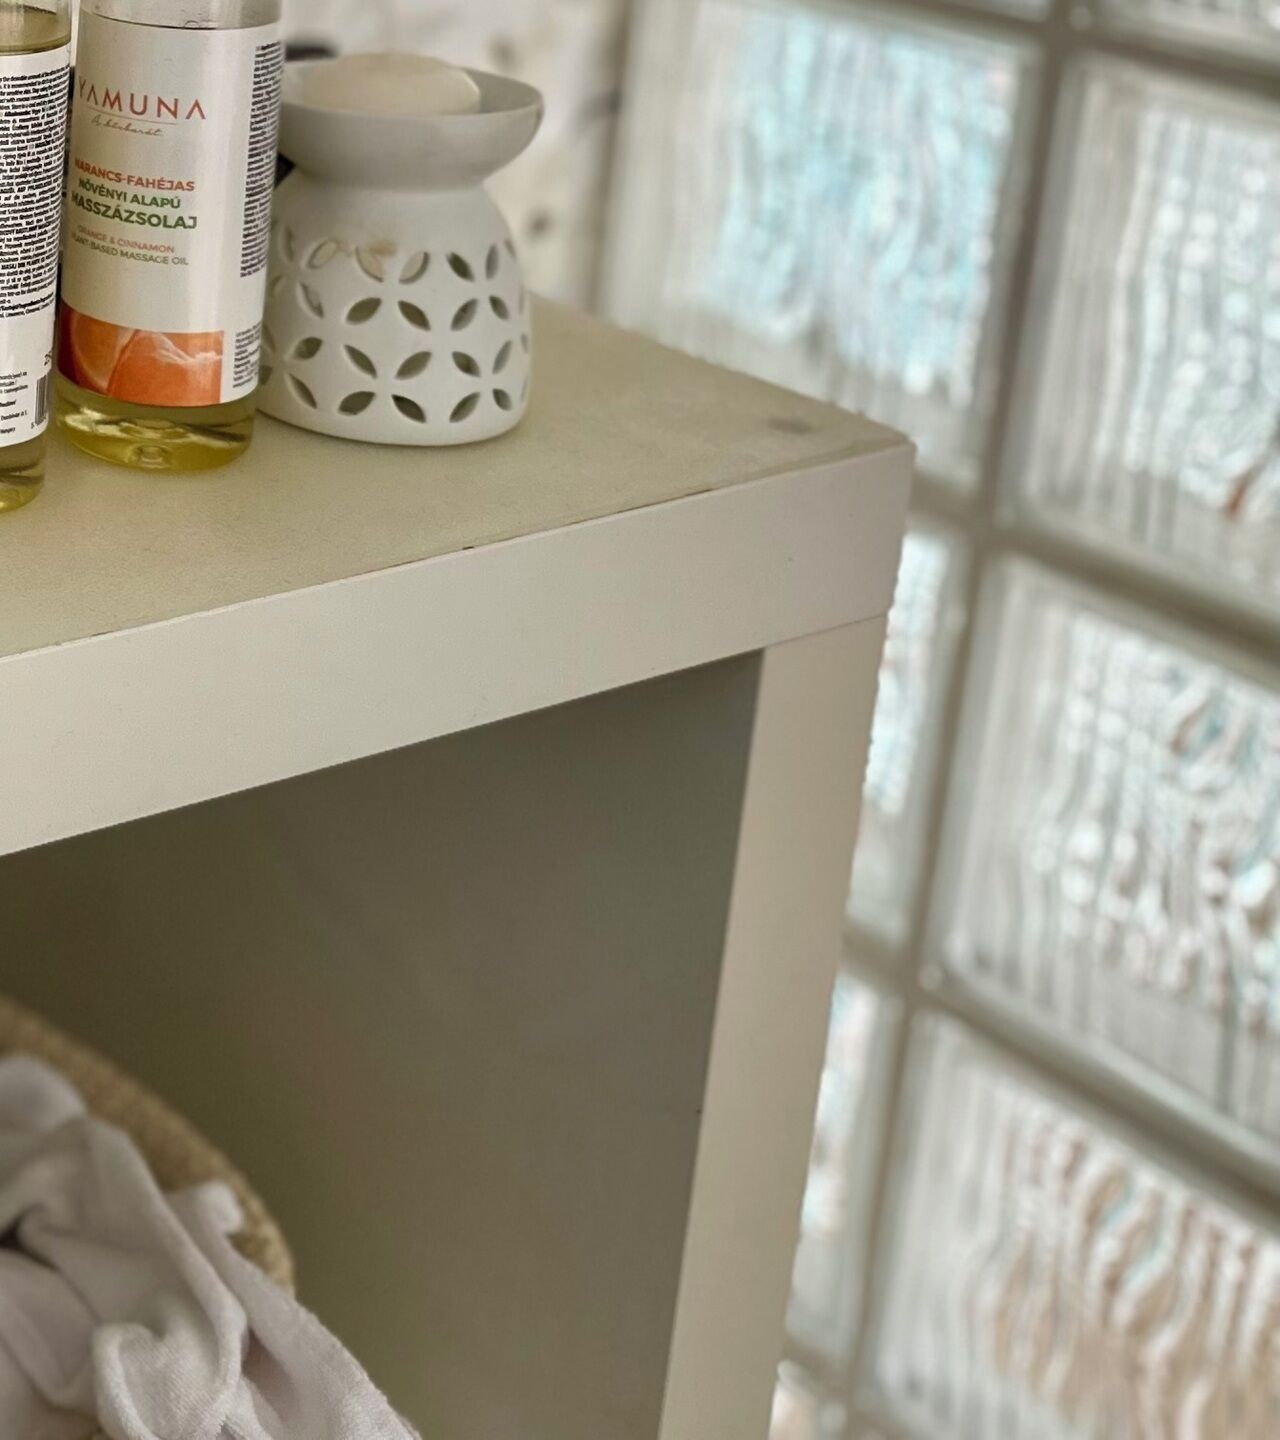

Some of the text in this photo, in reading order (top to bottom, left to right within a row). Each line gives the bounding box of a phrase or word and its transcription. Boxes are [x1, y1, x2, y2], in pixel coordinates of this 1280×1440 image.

[78, 76, 206, 120] YAMUNA
[75, 157, 195, 192] NARANCS-FAHÉJAS
[71, 191, 198, 229] MASSZÁZSOLAJ
[78, 178, 181, 209] NÖVÉNYI ALAPÚ
[117, 238, 175, 253] CINNAMON
[120, 250, 169, 265] MASSAGE
[172, 256, 189, 266] OIL
